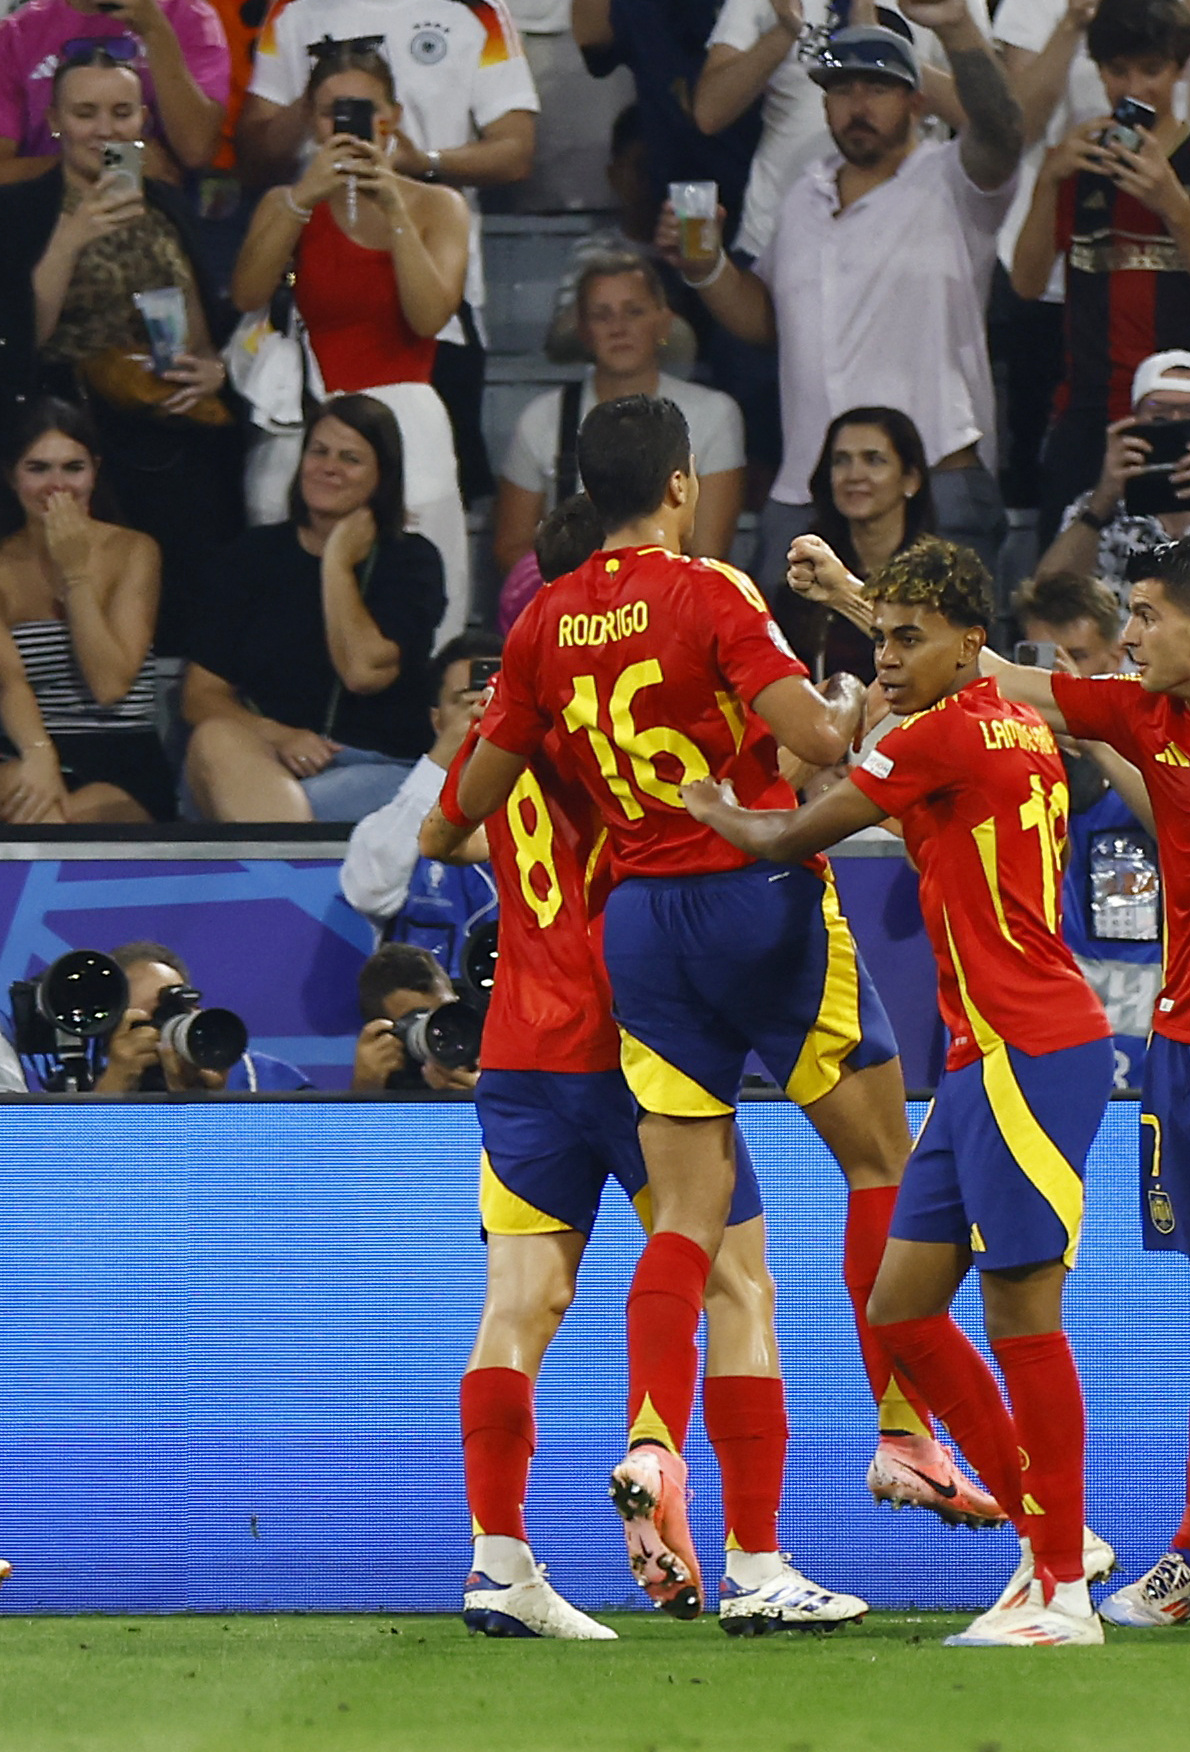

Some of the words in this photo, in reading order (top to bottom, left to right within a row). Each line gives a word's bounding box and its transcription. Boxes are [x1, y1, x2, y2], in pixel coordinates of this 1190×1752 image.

[558, 600, 649, 648] RODRIGO
[561, 658, 711, 821] 16
[506, 767, 563, 929] 8
[1141, 1114, 1161, 1177] 7
